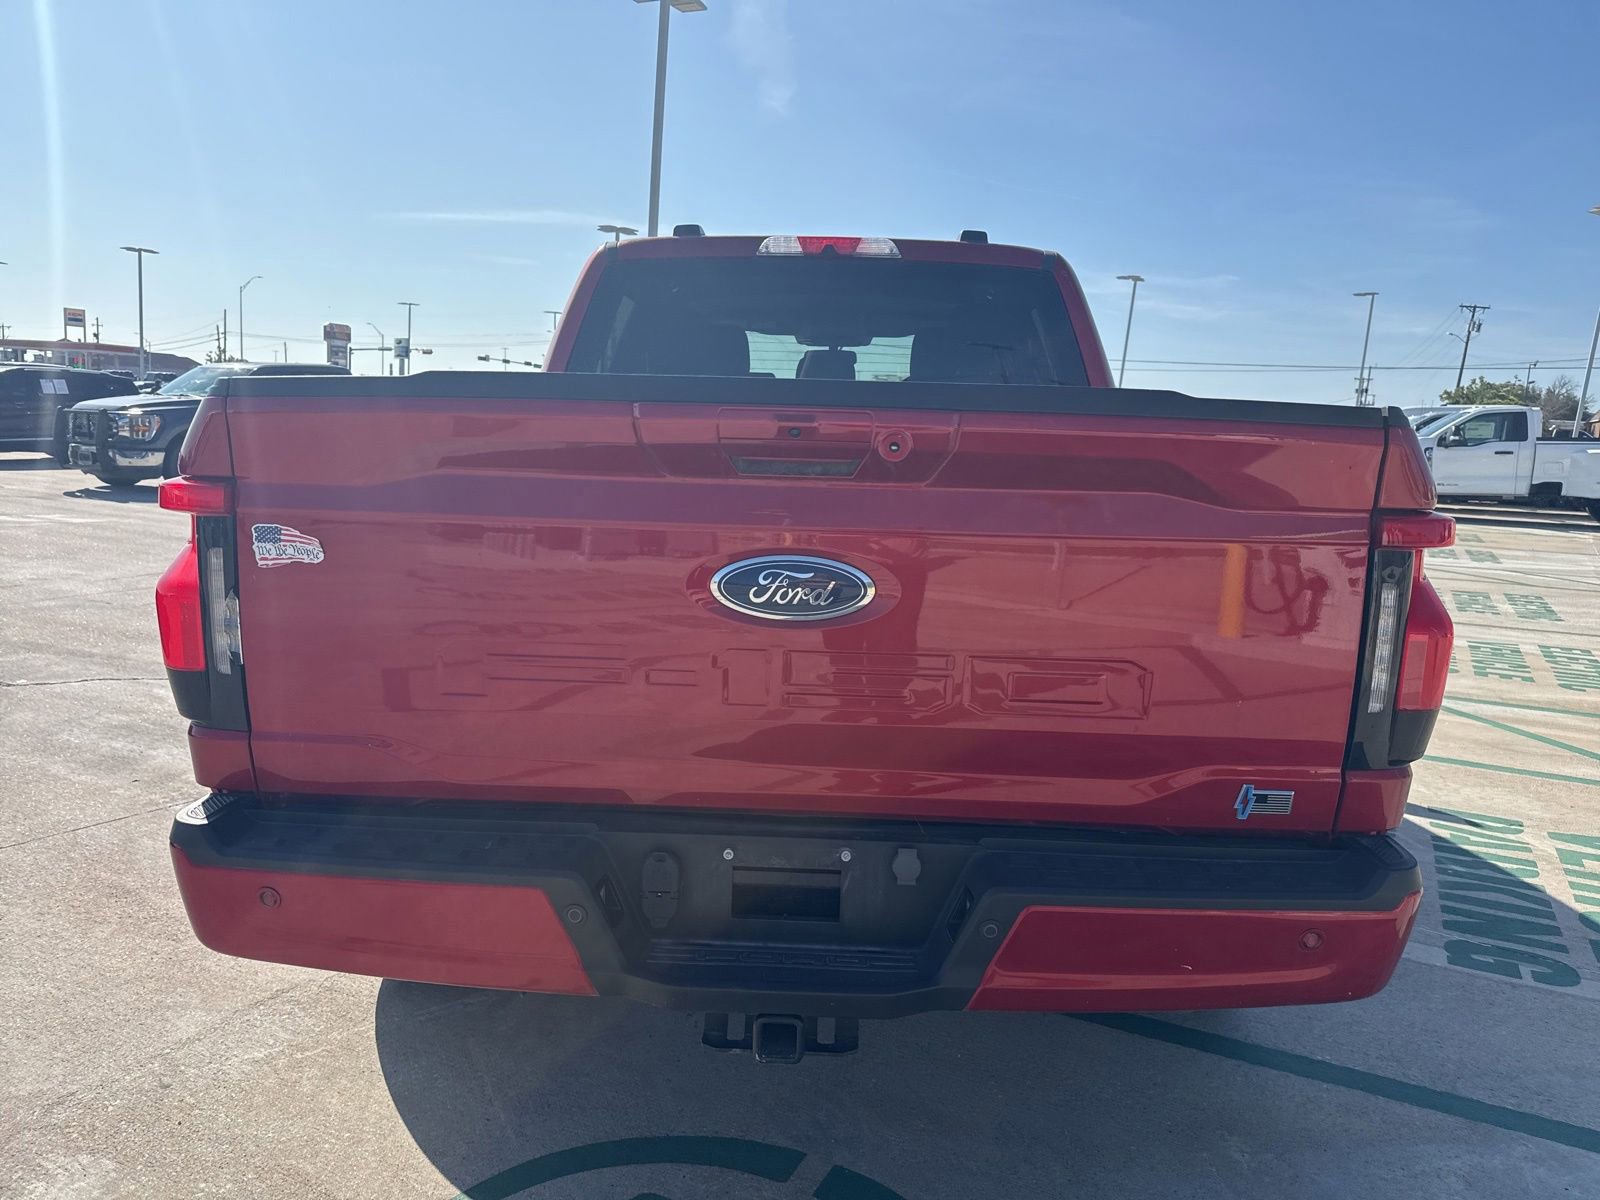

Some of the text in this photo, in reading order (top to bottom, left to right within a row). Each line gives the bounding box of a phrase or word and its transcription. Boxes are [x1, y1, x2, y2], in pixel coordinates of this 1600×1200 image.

[257, 544, 272, 556] We
[288, 543, 322, 560] People
[749, 569, 836, 606] Ford
[436, 642, 1153, 720] F-150
[1467, 640, 1536, 683] VEHICLE
[1427, 806, 1581, 987] PARKING
